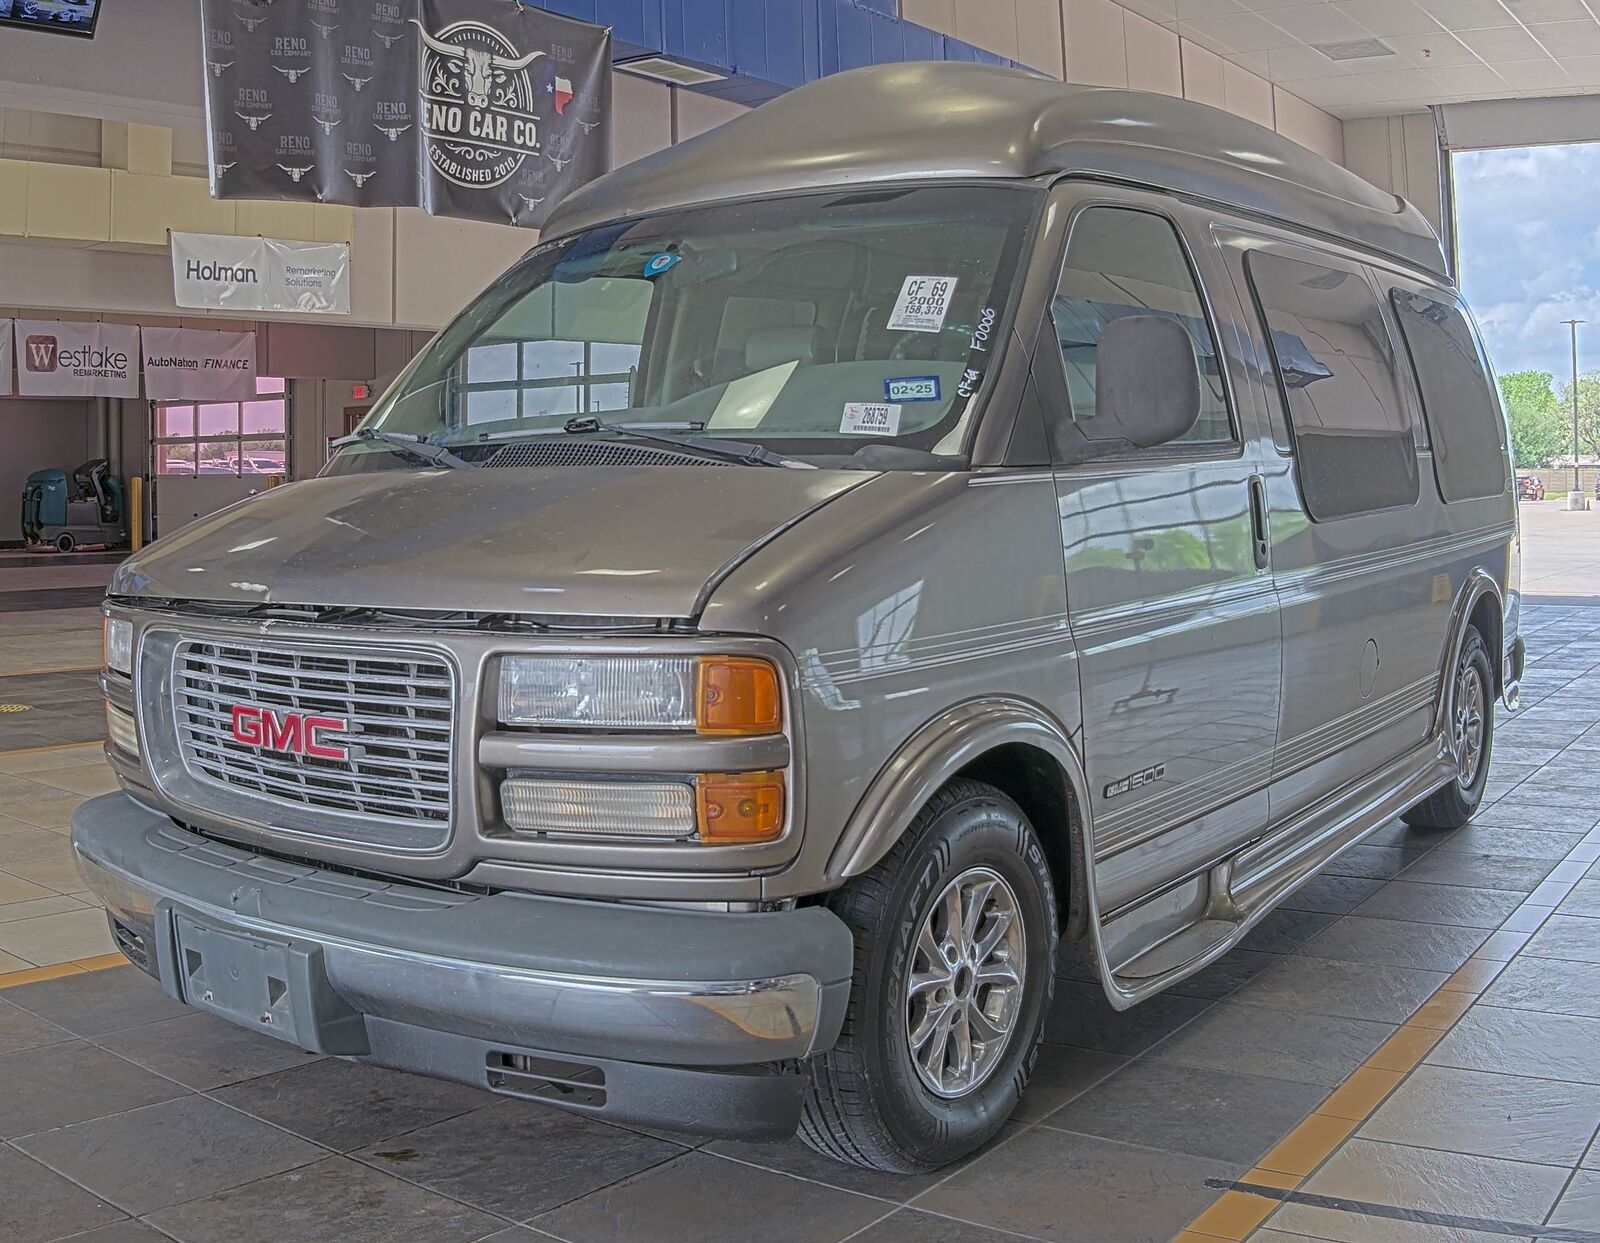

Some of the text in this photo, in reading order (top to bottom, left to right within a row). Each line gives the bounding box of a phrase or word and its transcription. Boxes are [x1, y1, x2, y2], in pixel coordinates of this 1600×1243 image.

[375, 4, 400, 18] RENO
[275, 37, 307, 50] RENO
[345, 45, 370, 60] RENO
[552, 44, 573, 58] RENO
[352, 58, 374, 67] COMPANY
[239, 87, 268, 102] RENO
[315, 93, 338, 109] RENO
[245, 102, 273, 110] COMPANY
[376, 102, 407, 115] RENO
[424, 102, 540, 148] ENO CAR CO.
[280, 135, 310, 149] RENO
[347, 143, 371, 156] RENO
[429, 144, 516, 182] ESTABLISHED 2010
[186, 260, 258, 283] Holman
[286, 266, 336, 279] Remarketing
[285, 278, 322, 288] Solutions
[907, 280, 948, 297] CF 69
[908, 296, 945, 306] 2000
[904, 305, 944, 316] 158,378
[29, 343, 128, 370] Westlake
[147, 356, 249, 370] AutoNation FINANCE
[73, 369, 127, 379] REMARKETING
[232, 704, 349, 761] GMC
